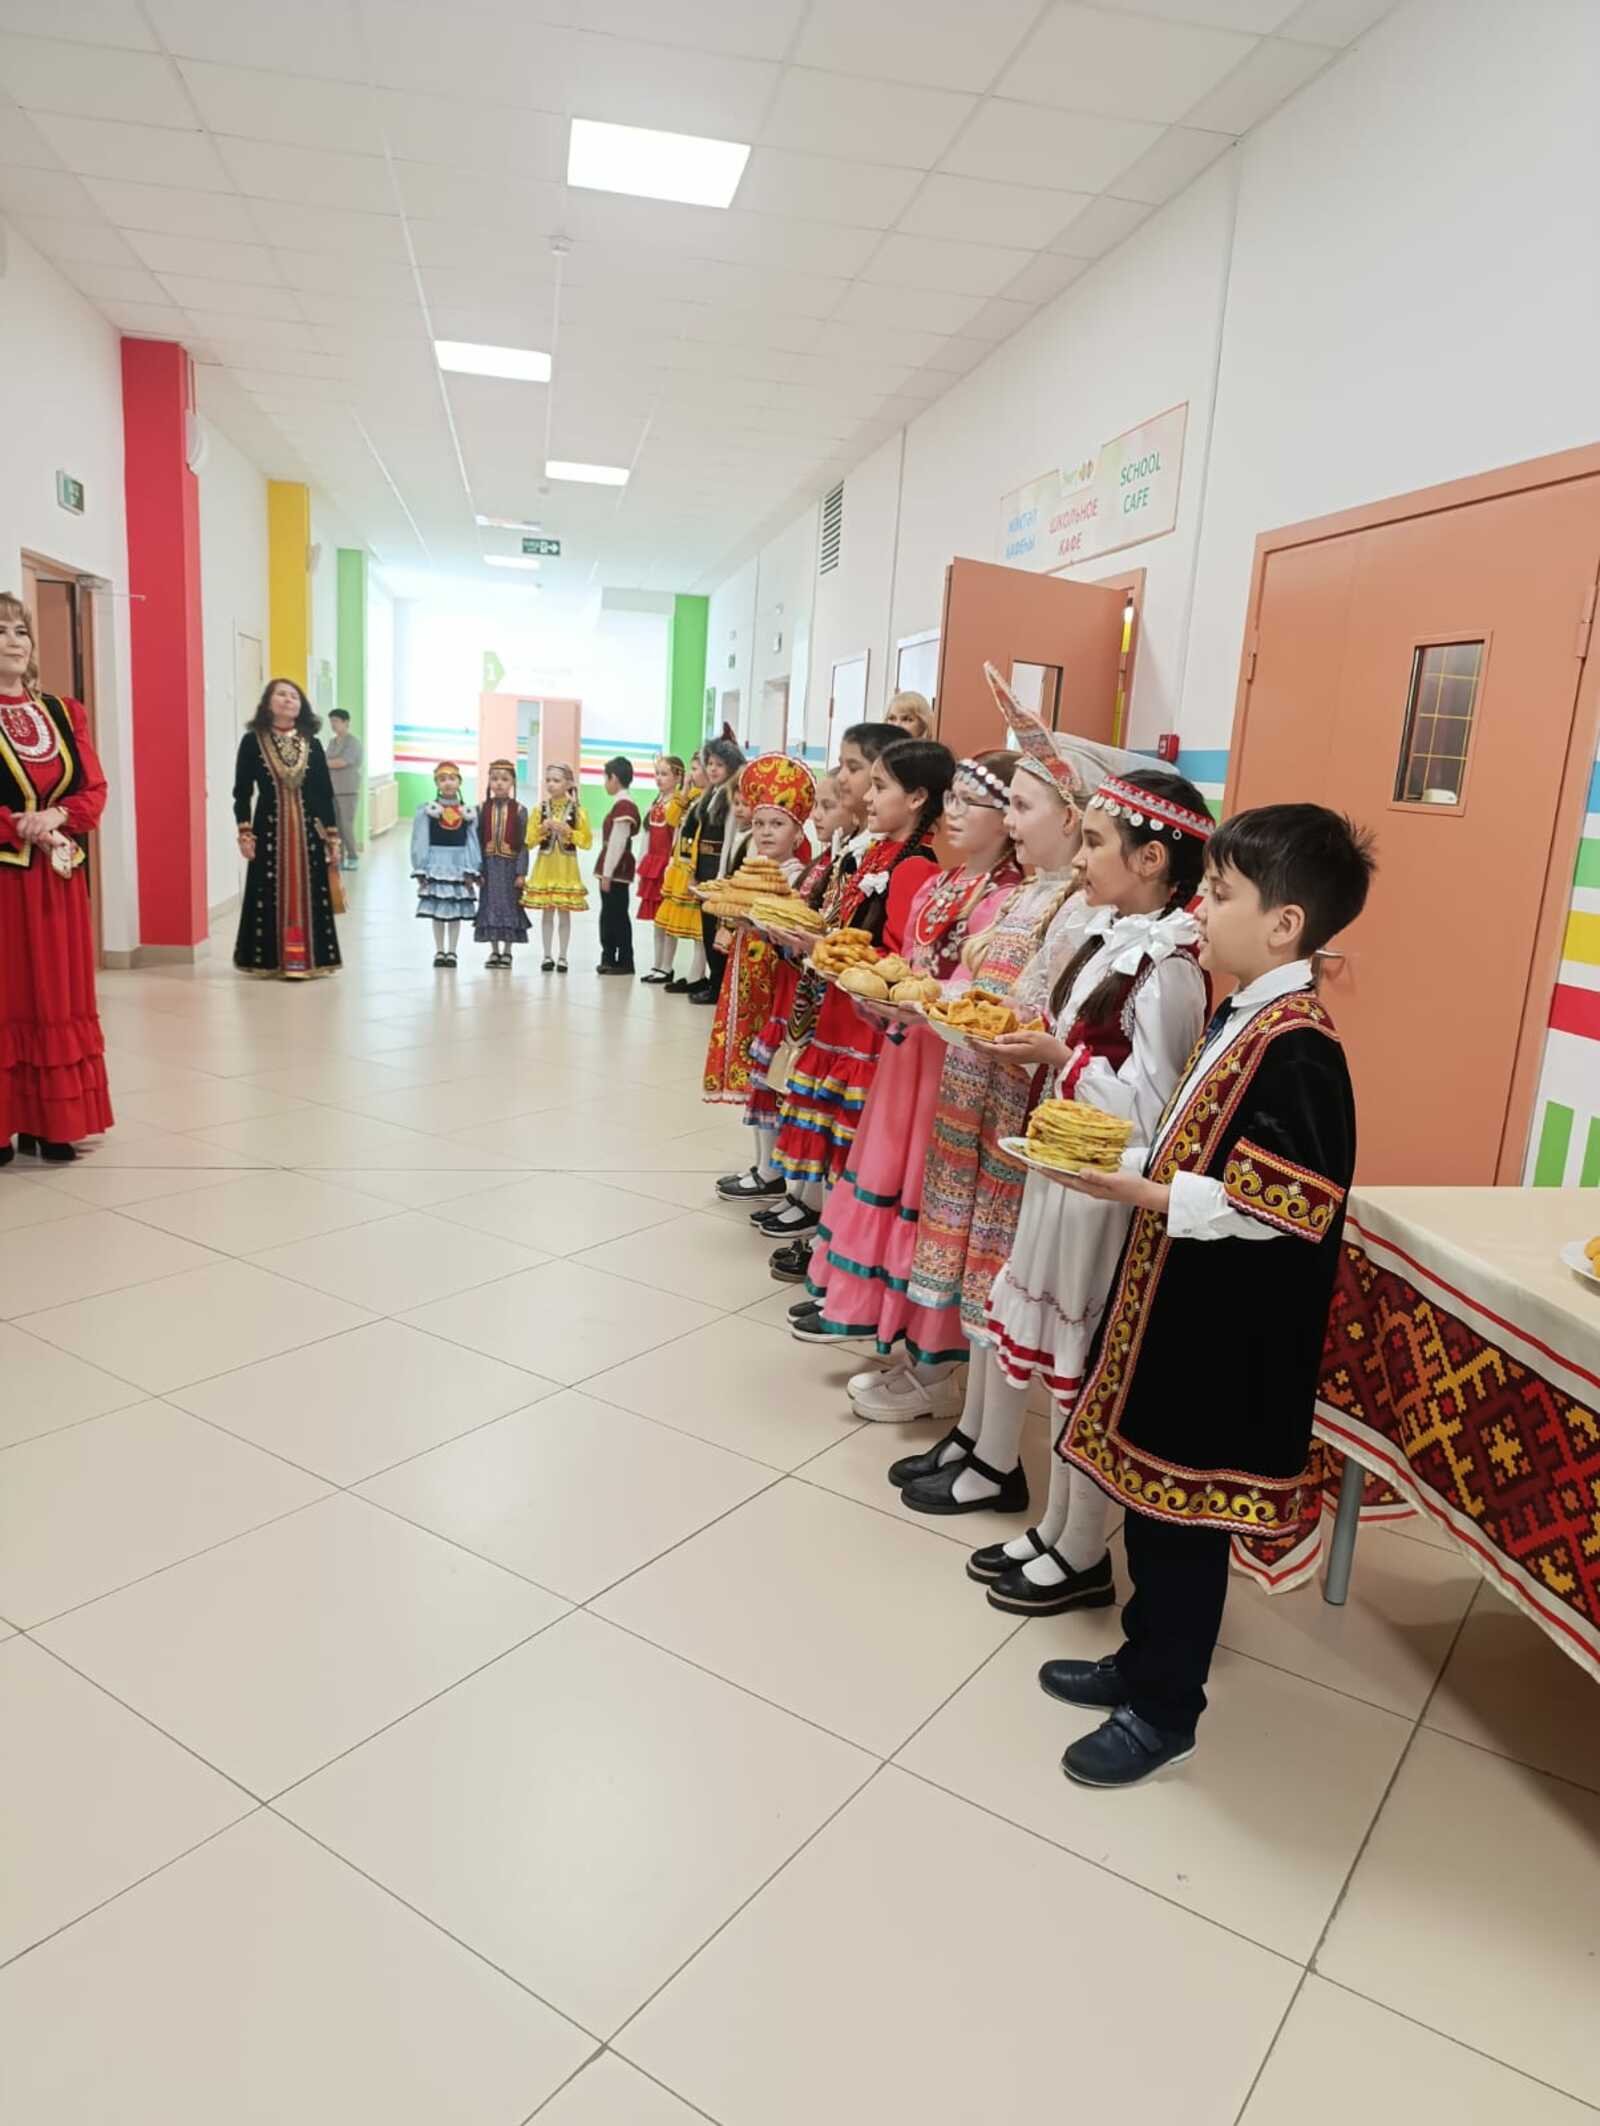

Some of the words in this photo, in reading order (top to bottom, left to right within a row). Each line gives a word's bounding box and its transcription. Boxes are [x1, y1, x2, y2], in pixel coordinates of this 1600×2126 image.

[1119, 452, 1161, 486] SCHOOL
[1123, 487, 1150, 514] CAFE
[1049, 498, 1098, 534] ШКОЛЬНОЕ
[1059, 532, 1083, 555] КАФЕ
